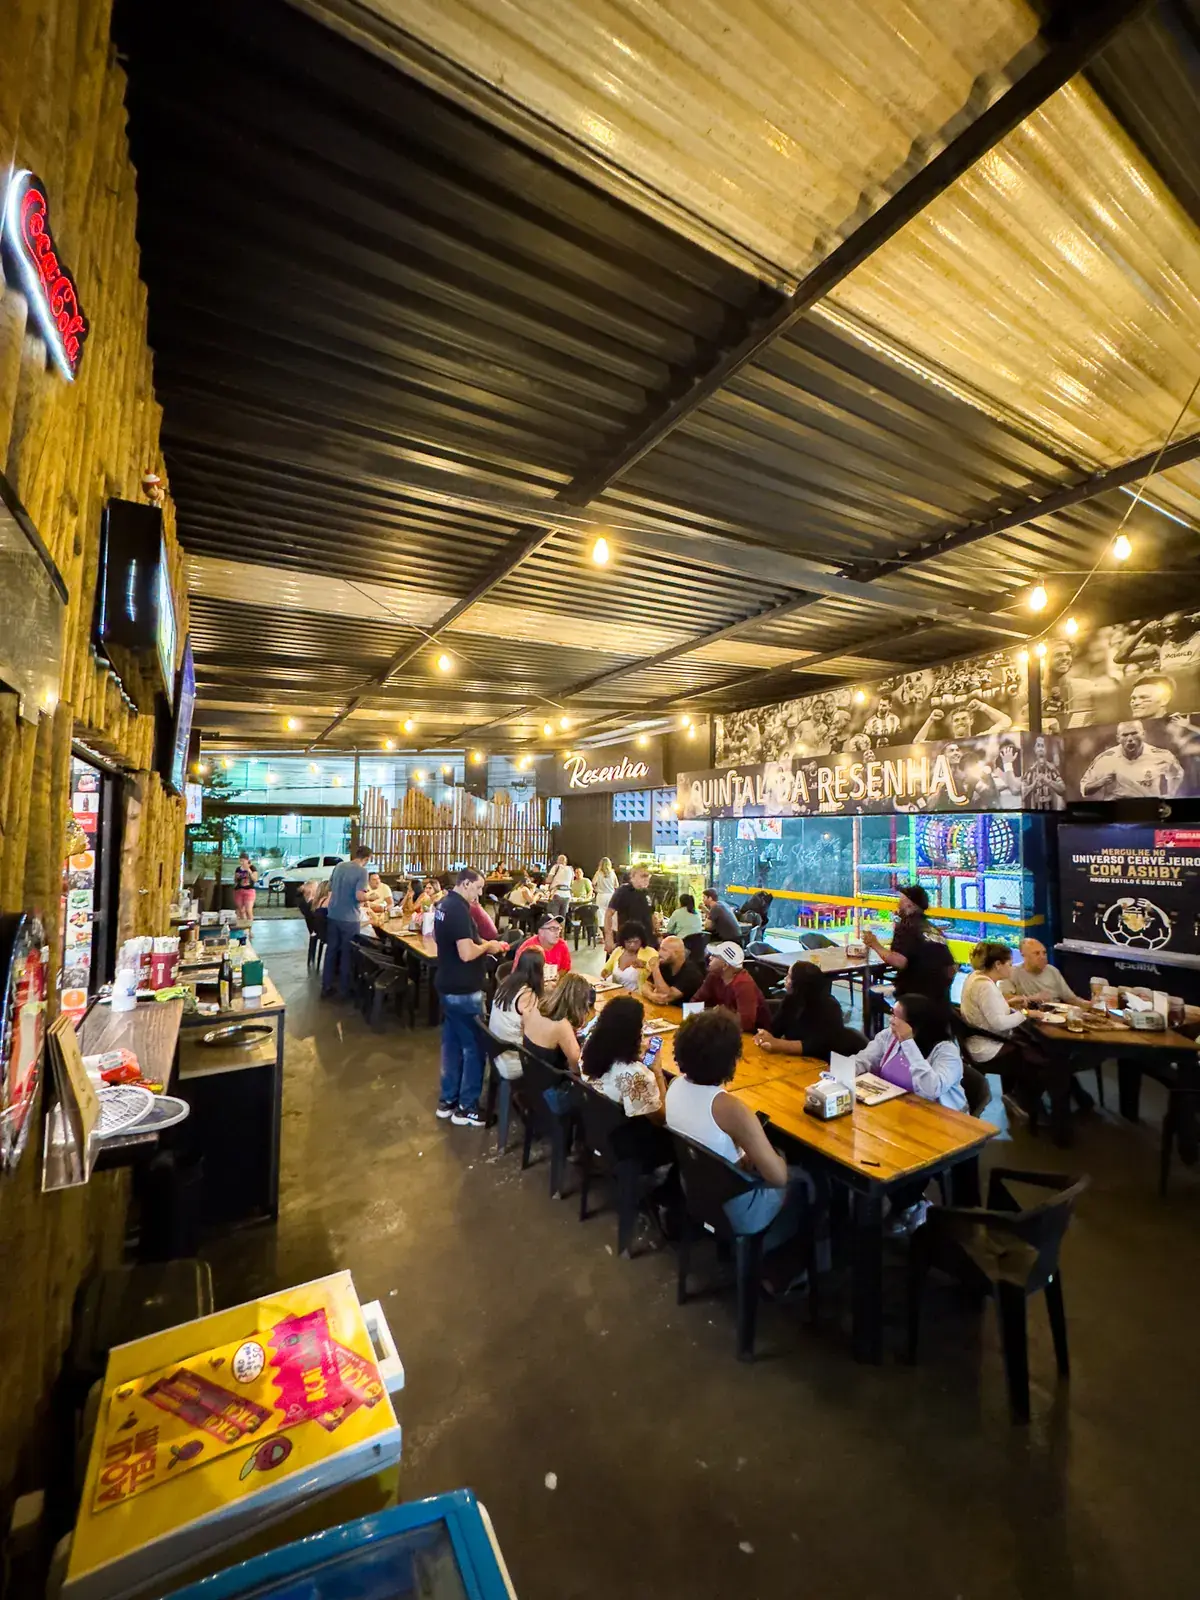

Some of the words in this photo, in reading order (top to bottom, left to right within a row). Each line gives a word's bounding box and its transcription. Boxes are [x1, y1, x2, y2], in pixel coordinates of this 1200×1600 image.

[563, 756, 650, 789] Resenha
[691, 769, 767, 815] QUINTAL
[818, 754, 969, 810] RESENHA
[1072, 855, 1125, 864] UNIVERSO
[1127, 857, 1200, 866] CERVEJEIRO
[1101, 848, 1151, 856] MERGULHE
[1090, 864, 1122, 876] COM
[1127, 865, 1181, 878] ASHBY
[97, 1440, 132, 1504] AQUI
